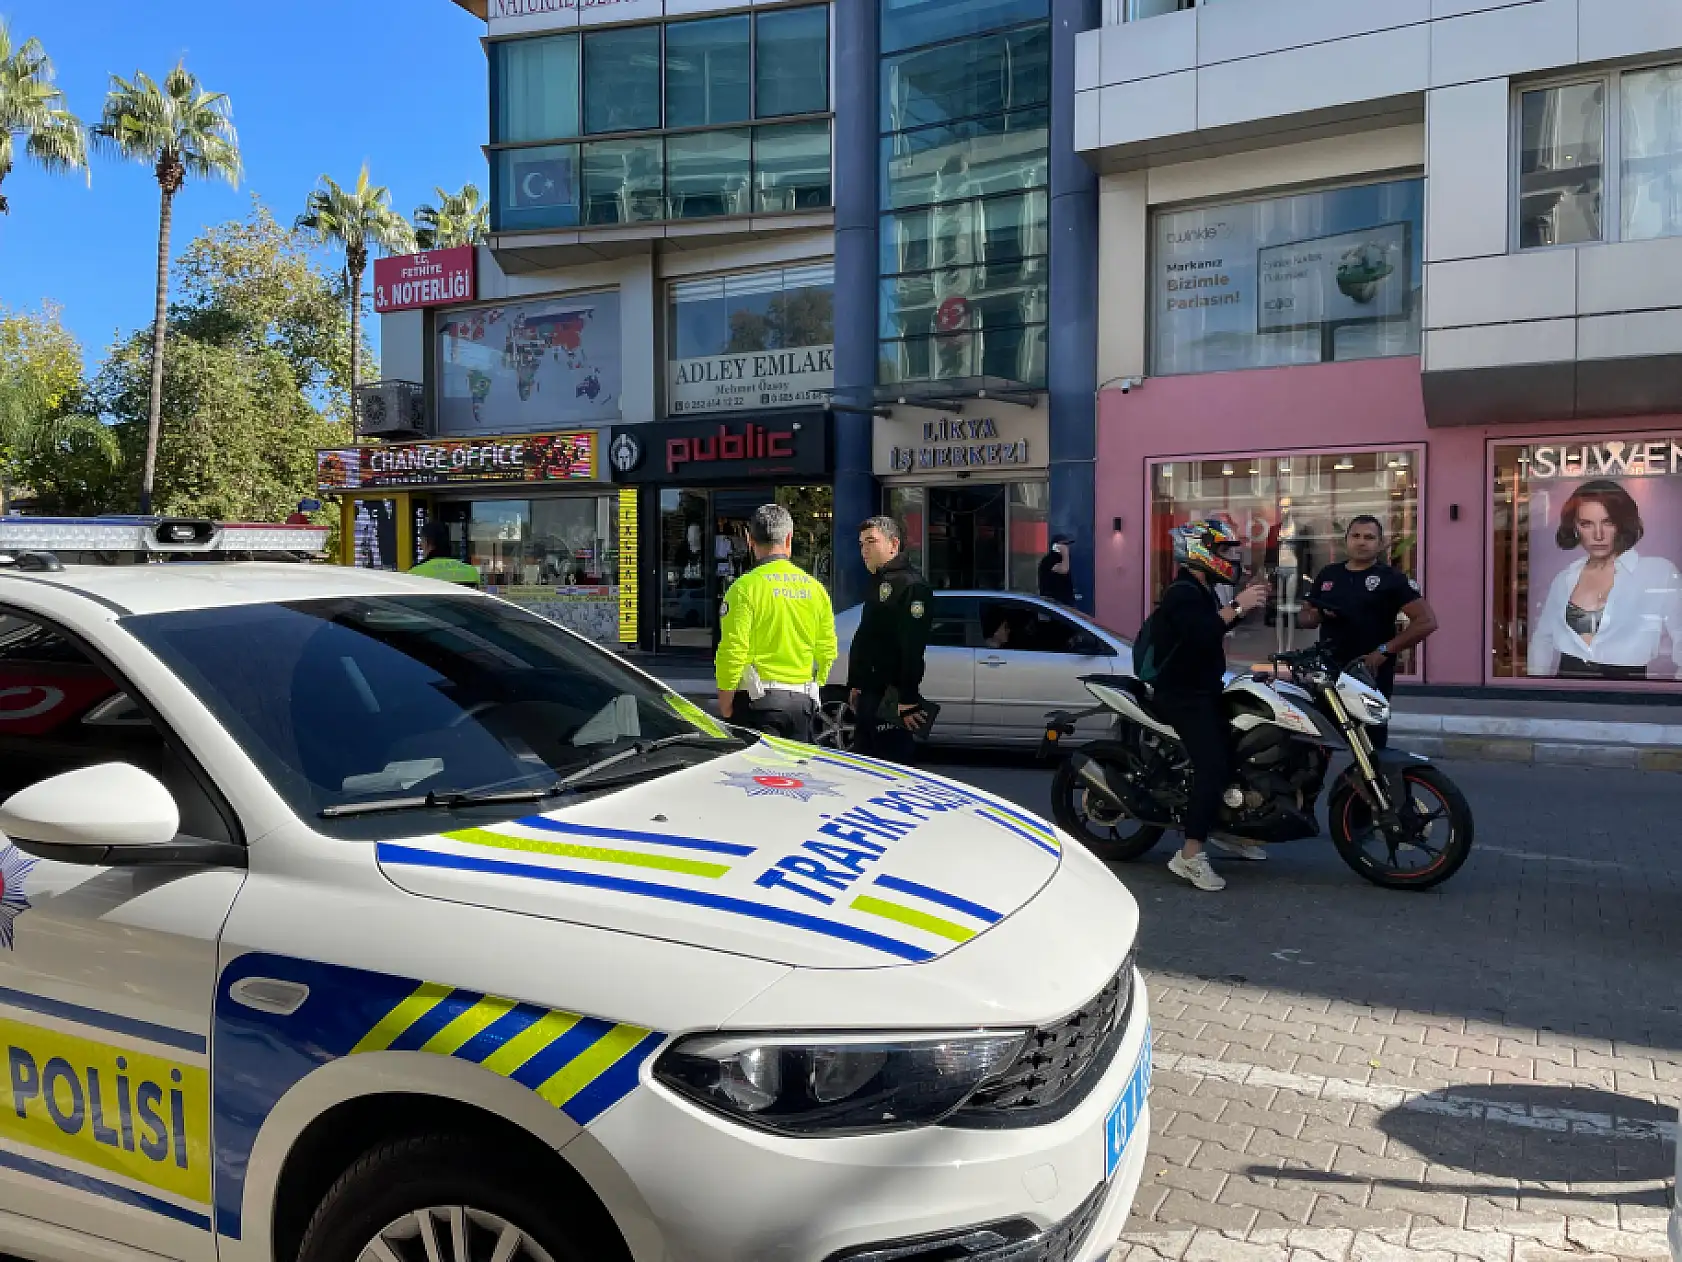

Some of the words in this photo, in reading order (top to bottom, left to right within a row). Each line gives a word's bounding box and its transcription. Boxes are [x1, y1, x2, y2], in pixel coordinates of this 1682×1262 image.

[376, 284, 388, 307] 3.
[391, 268, 470, 306] NOTERLİĞİ
[1166, 273, 1231, 292] Bizimle
[675, 357, 747, 385] ADLEY
[752, 348, 834, 378] EMLAK
[370, 449, 448, 471] CHANGE
[452, 445, 524, 467] OFFICE
[666, 422, 793, 473] public
[753, 806, 918, 906] TRAFİK
[8, 1044, 189, 1171] POLİSİ
